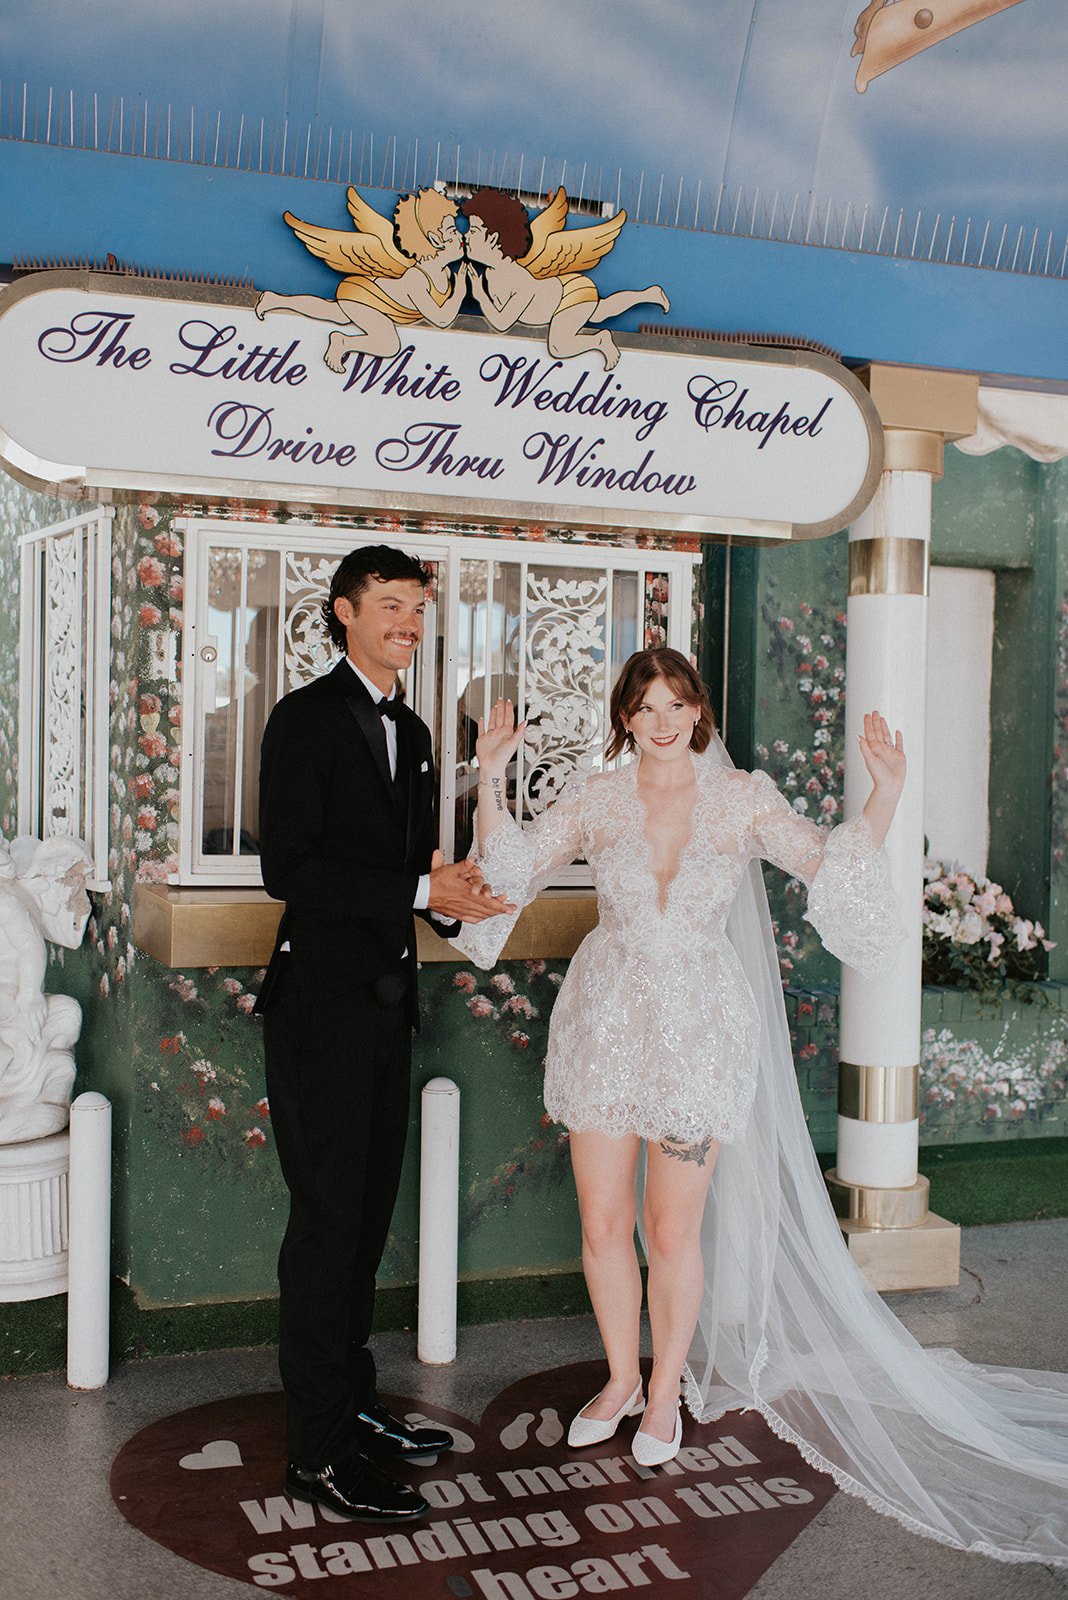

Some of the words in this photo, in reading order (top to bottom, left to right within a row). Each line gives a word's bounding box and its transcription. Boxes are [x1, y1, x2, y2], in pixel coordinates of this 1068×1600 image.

[38, 311, 151, 371] The
[170, 319, 308, 386] Little
[340, 345, 461, 402] White
[479, 353, 669, 441] Wedding
[687, 374, 833, 450] Chapel
[207, 400, 356, 467] Drive
[375, 422, 505, 480] Thru
[522, 431, 697, 496] Window
[494, 790, 504, 811] brave
[404, 1471, 496, 1509] ot
[247, 1509, 581, 1587] standing
[584, 1496, 681, 1533] on
[674, 1476, 815, 1519] this
[471, 1543, 692, 1600] heart
